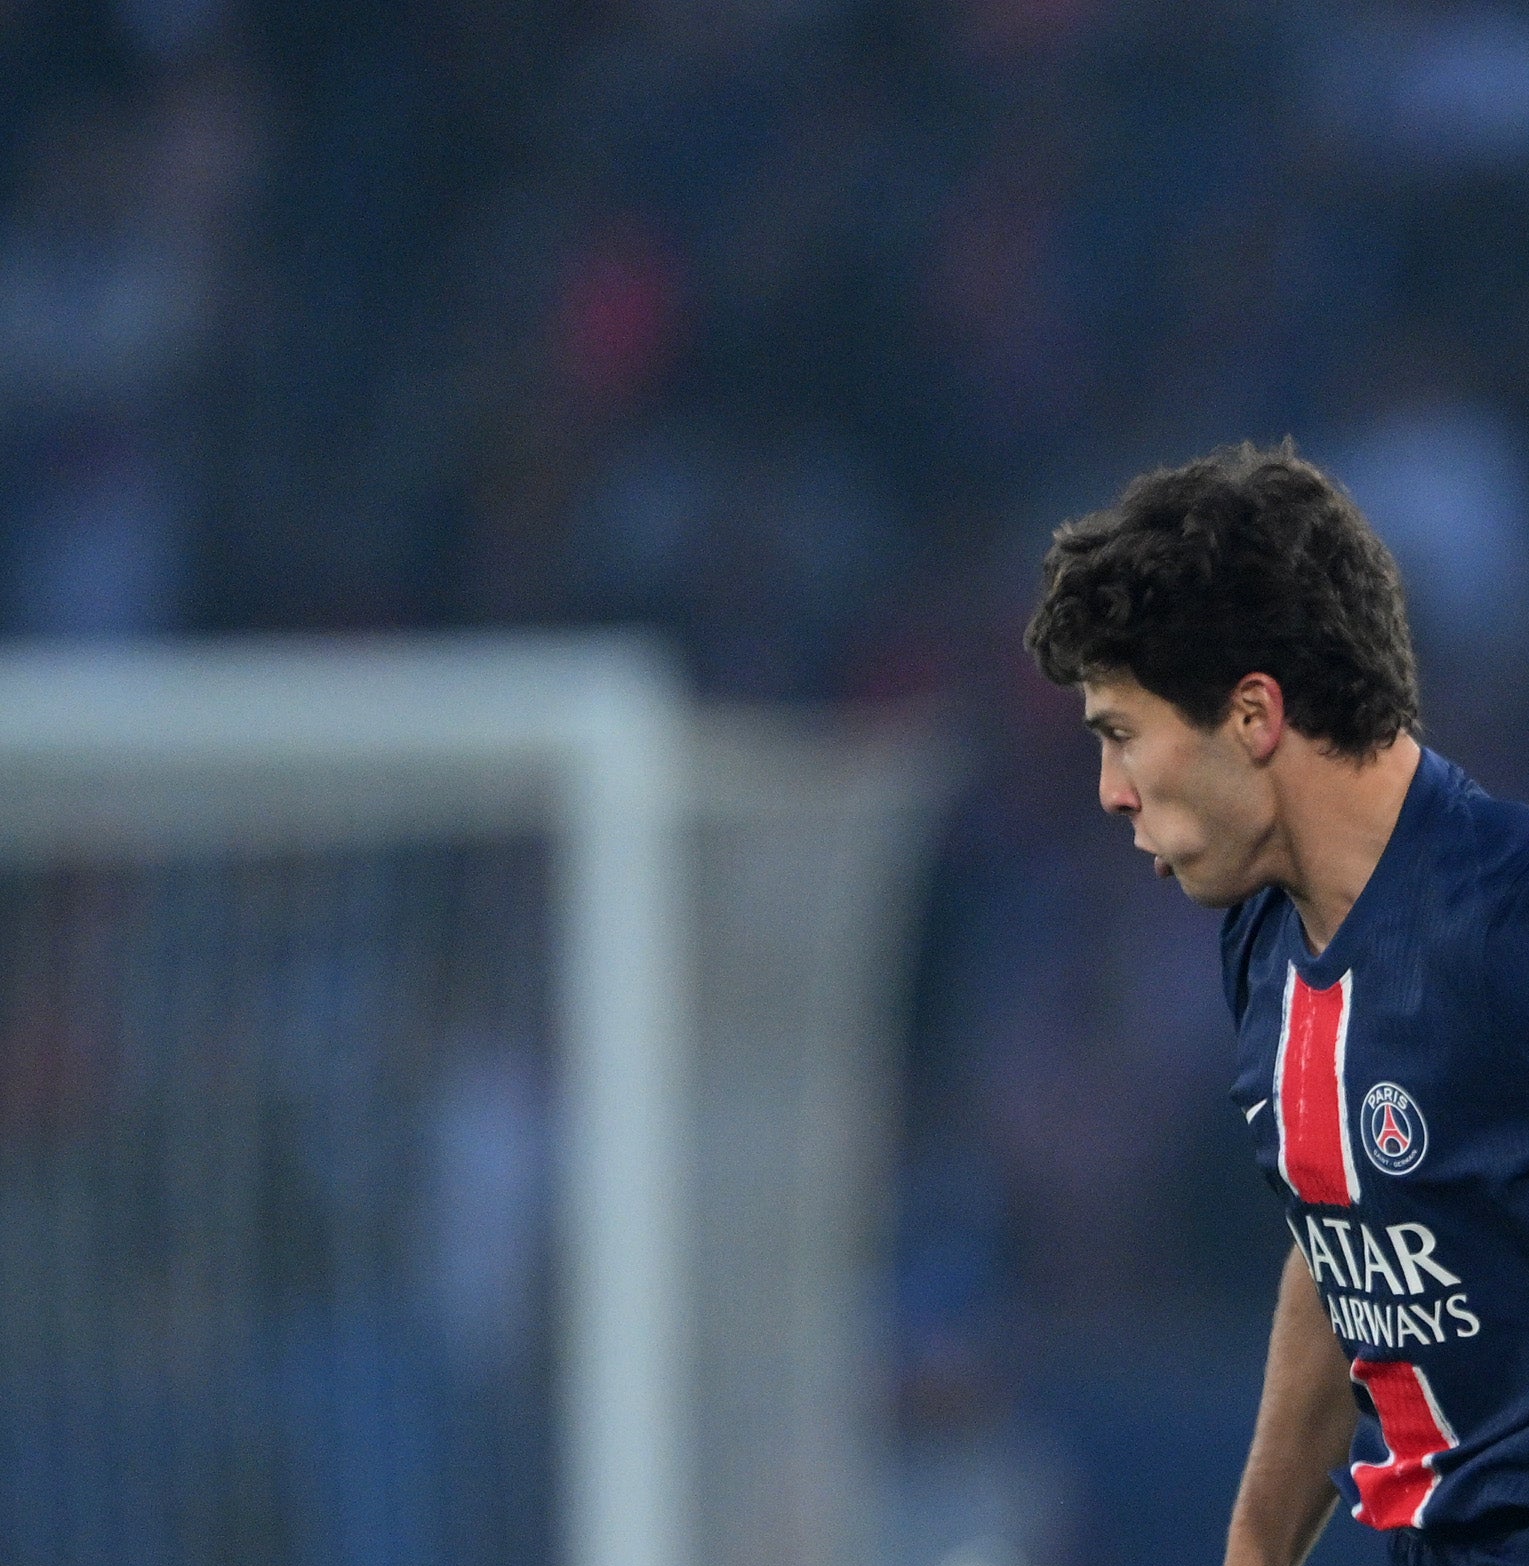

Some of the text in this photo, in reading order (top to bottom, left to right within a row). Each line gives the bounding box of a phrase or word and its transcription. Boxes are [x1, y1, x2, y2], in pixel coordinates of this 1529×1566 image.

[1368, 1087, 1408, 1110] PARIS
[1286, 1215, 1462, 1295] ATAR
[1327, 1294, 1481, 1348] AIRWAYS
